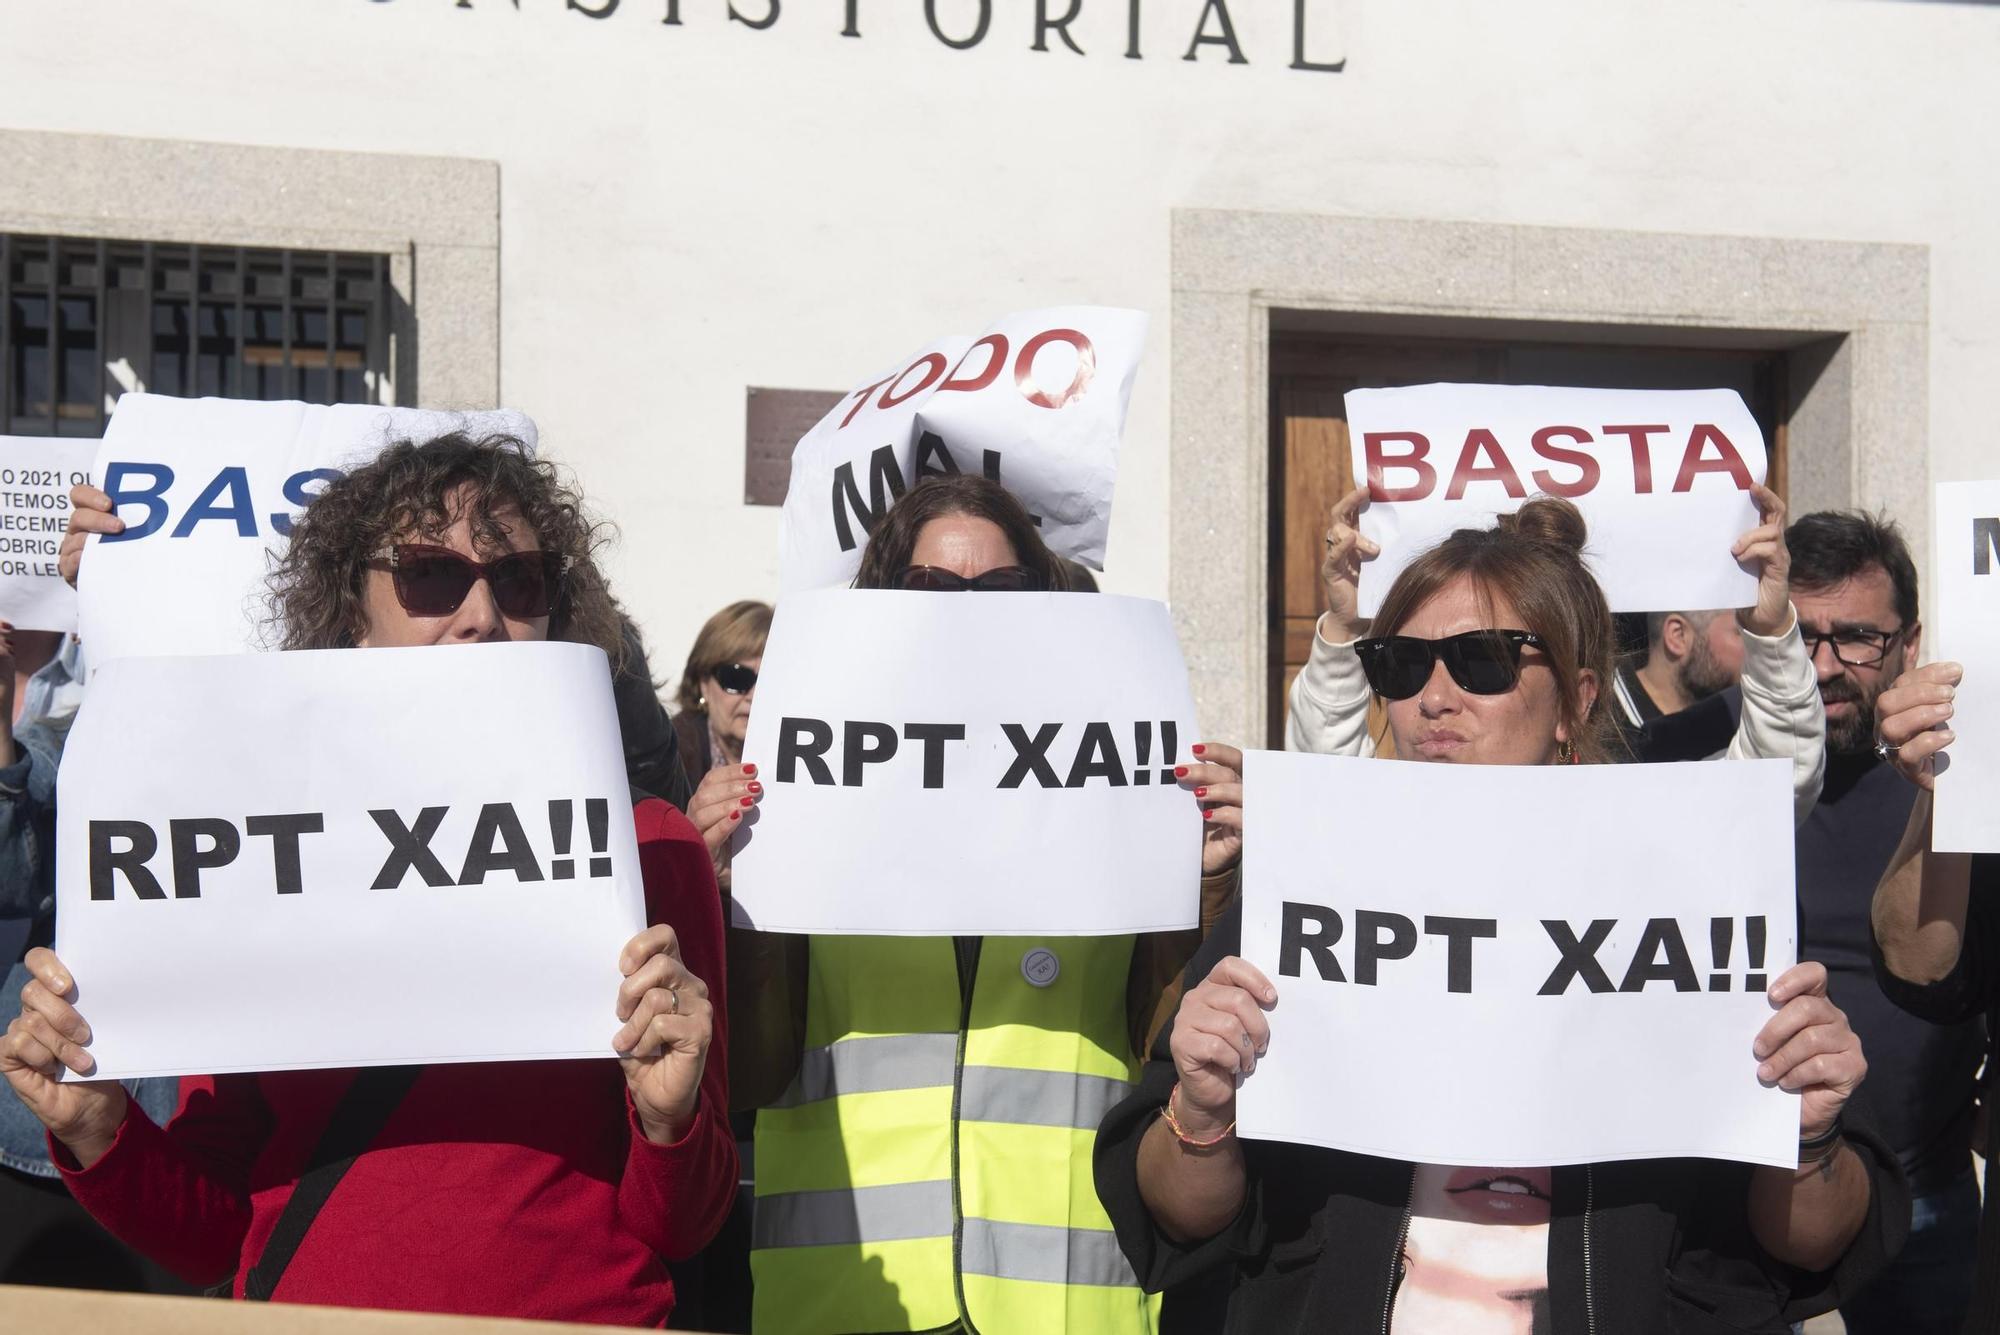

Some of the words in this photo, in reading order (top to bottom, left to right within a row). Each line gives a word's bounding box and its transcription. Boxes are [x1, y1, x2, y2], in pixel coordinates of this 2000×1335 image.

[838, 328, 1096, 429] TODO
[20, 470, 62, 487] 2021
[1363, 424, 1755, 503] BASTA
[0, 515, 69, 533] ECEME
[1, 492, 69, 510] TEMOS
[0, 537, 62, 556] OBRIG
[777, 717, 966, 789] RPT
[996, 720, 1178, 789] XA!!
[89, 813, 324, 900] RPT
[368, 798, 613, 890] XA!!
[1278, 901, 1497, 993] RPT
[1537, 915, 1769, 996] XA!!
